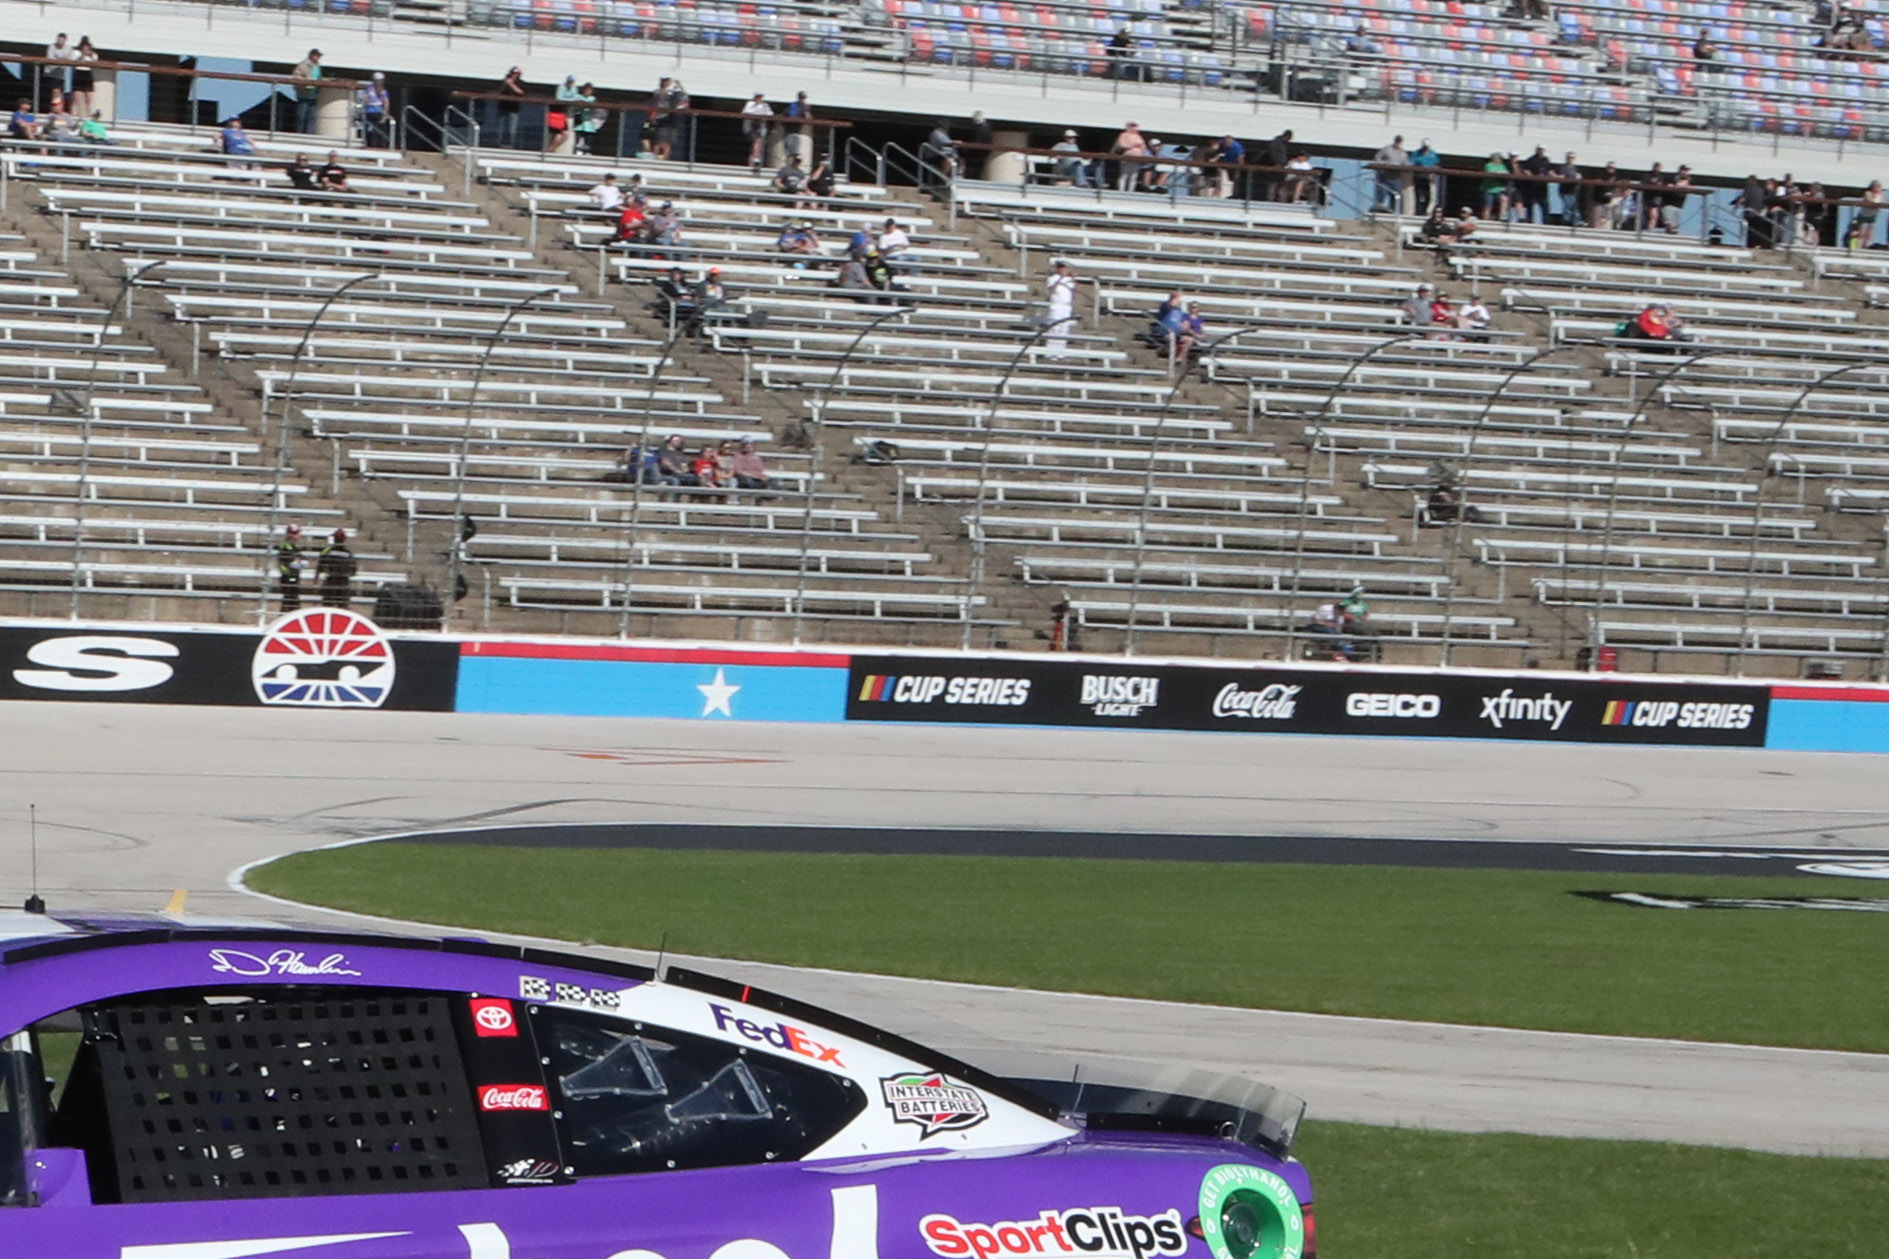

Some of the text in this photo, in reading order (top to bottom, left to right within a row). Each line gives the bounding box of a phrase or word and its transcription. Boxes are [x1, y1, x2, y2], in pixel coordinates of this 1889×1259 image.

[894, 676, 1031, 705] CUP SERIES
[1081, 675, 1159, 704] BUSCH
[1346, 693, 1441, 718] GEICO
[1480, 689, 1571, 730] xfinity
[1632, 701, 1754, 729] CUP SERIES
[708, 1002, 847, 1069] FedEx
[890, 1086, 973, 1100] INTERSTATE
[901, 1101, 980, 1113] BATTERIES
